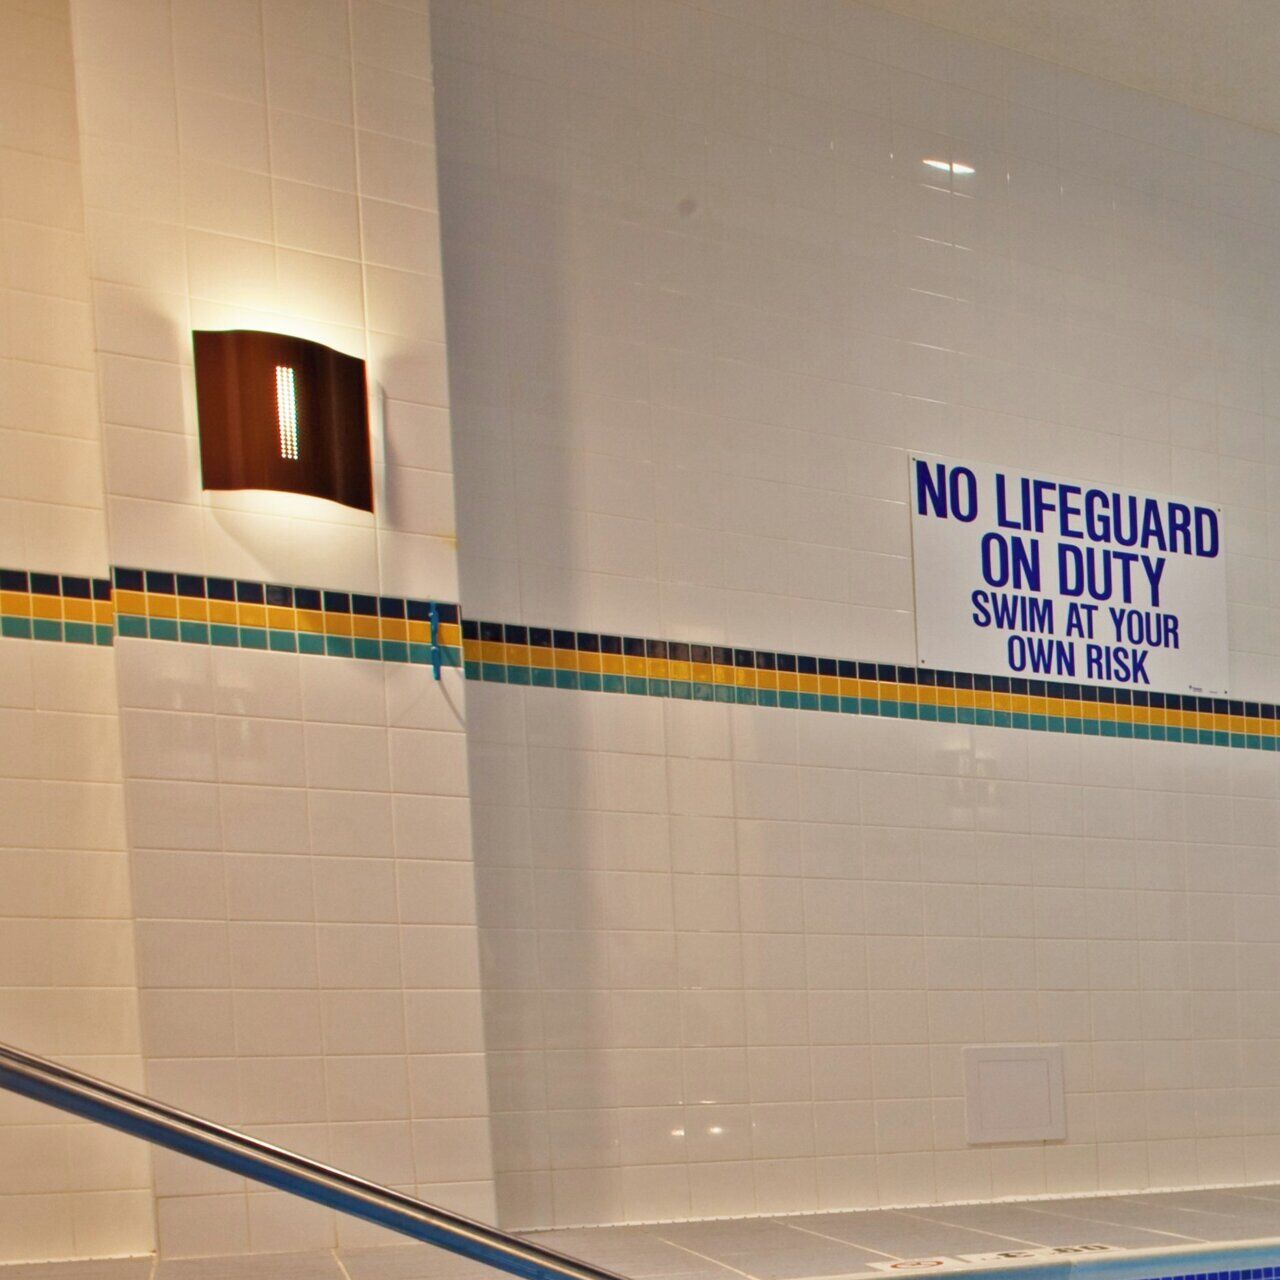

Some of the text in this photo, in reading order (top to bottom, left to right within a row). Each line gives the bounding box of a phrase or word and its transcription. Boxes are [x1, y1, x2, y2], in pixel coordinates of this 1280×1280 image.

[915, 460, 1220, 559] NO LIFEGUARD
[981, 532, 1167, 608] ON DUTY
[971, 590, 1180, 650] SWIM AT YOUR
[1007, 635, 1151, 685] OWN RISK
